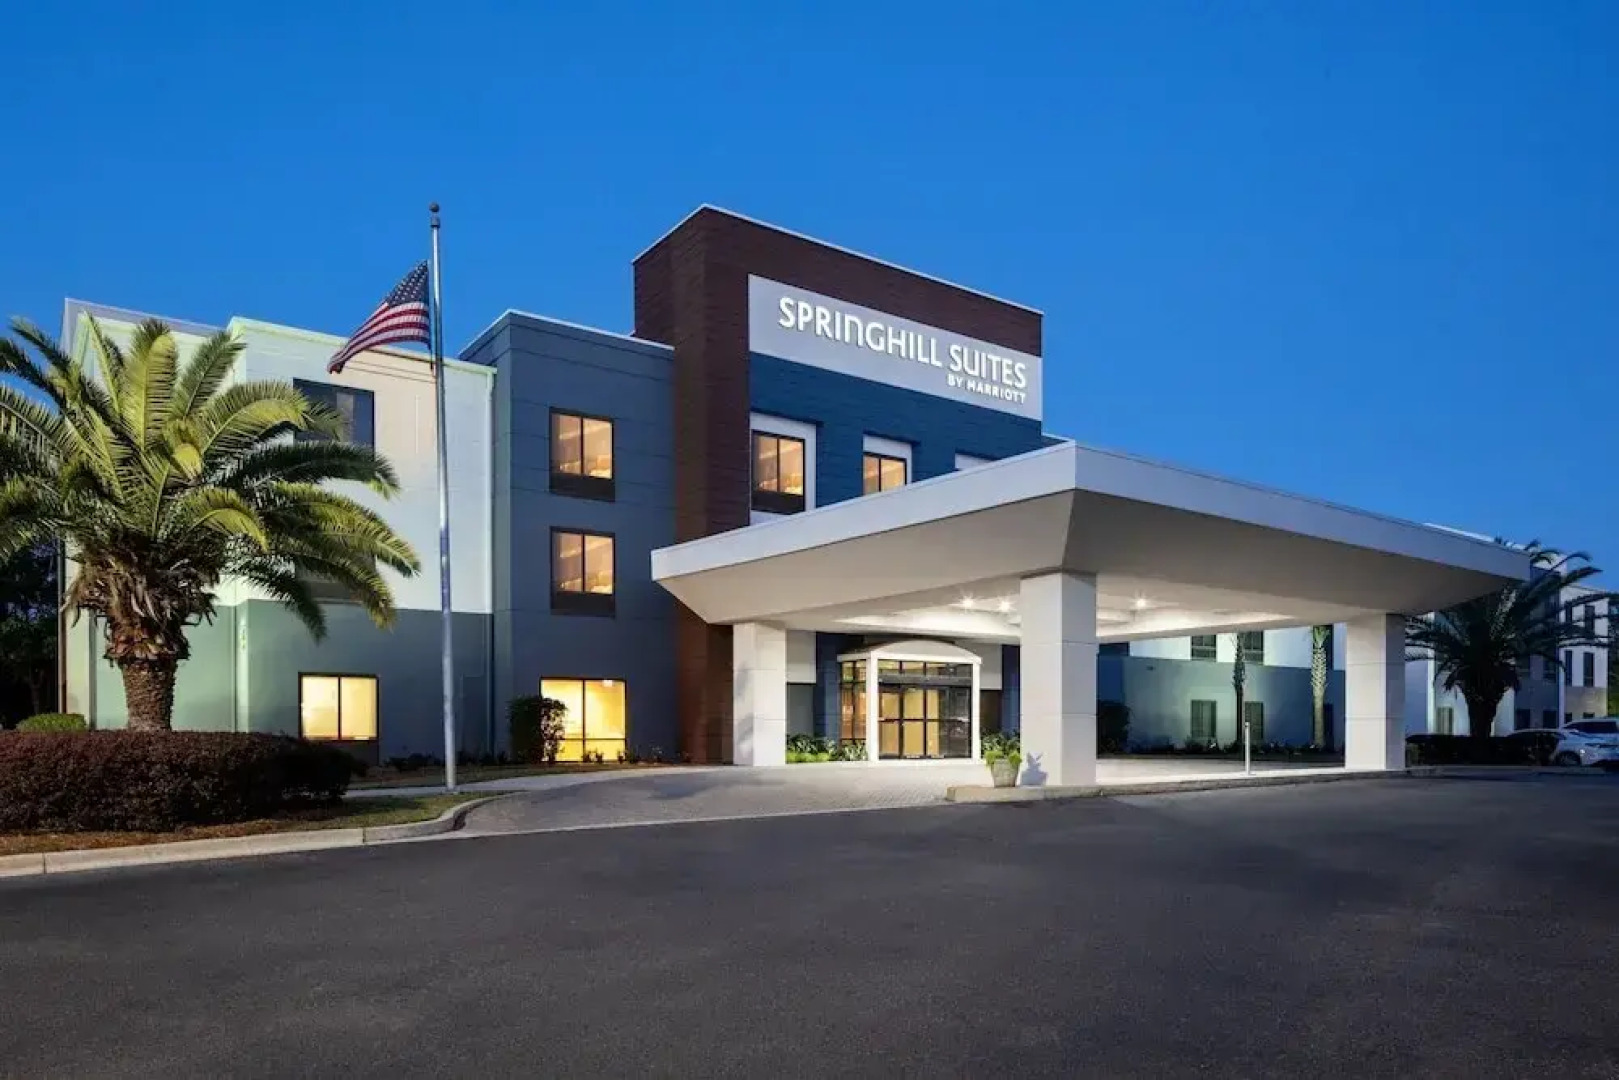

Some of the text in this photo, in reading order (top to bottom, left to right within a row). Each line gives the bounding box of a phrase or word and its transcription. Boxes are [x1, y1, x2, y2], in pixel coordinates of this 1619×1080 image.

[779, 297, 1026, 388] SPRINGHILL SUITES
[948, 373, 1026, 404] BY MARRIOTT
